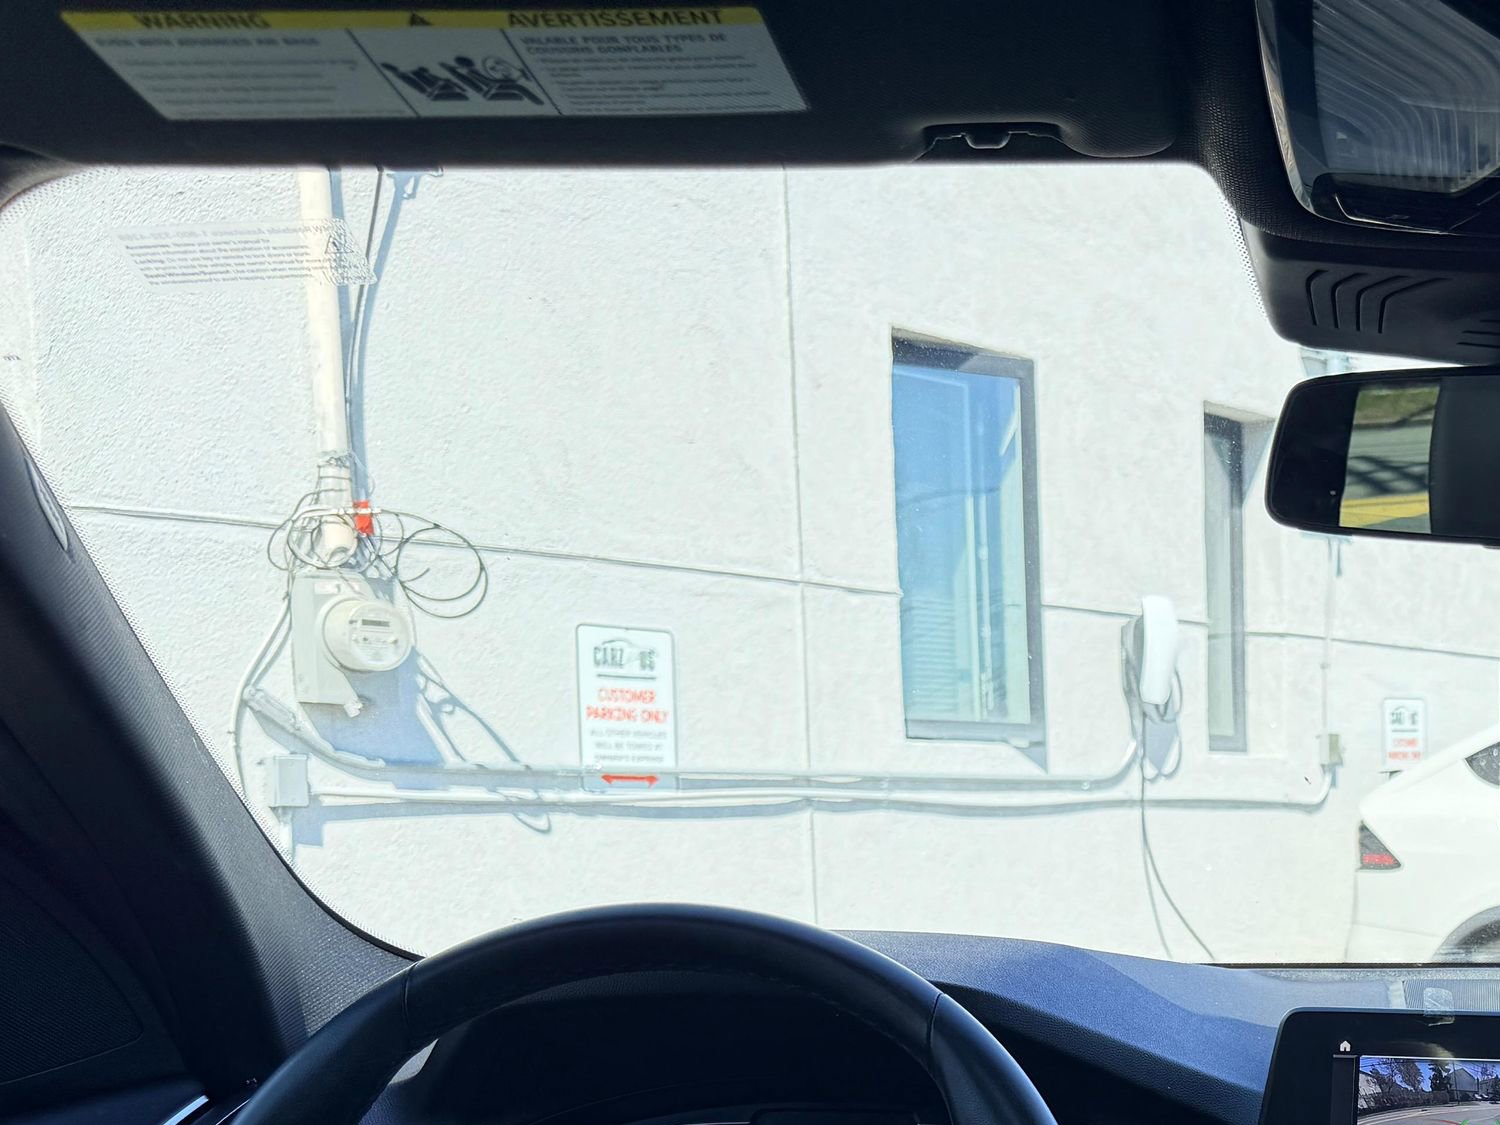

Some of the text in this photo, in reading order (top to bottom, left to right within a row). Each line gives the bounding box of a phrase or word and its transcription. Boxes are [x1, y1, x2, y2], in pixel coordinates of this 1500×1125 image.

[134, 9, 724, 29] WARNING AVERTISSEMENT
[597, 687, 657, 704] CUSTOMER
[585, 705, 670, 724] PARKING ONLY
